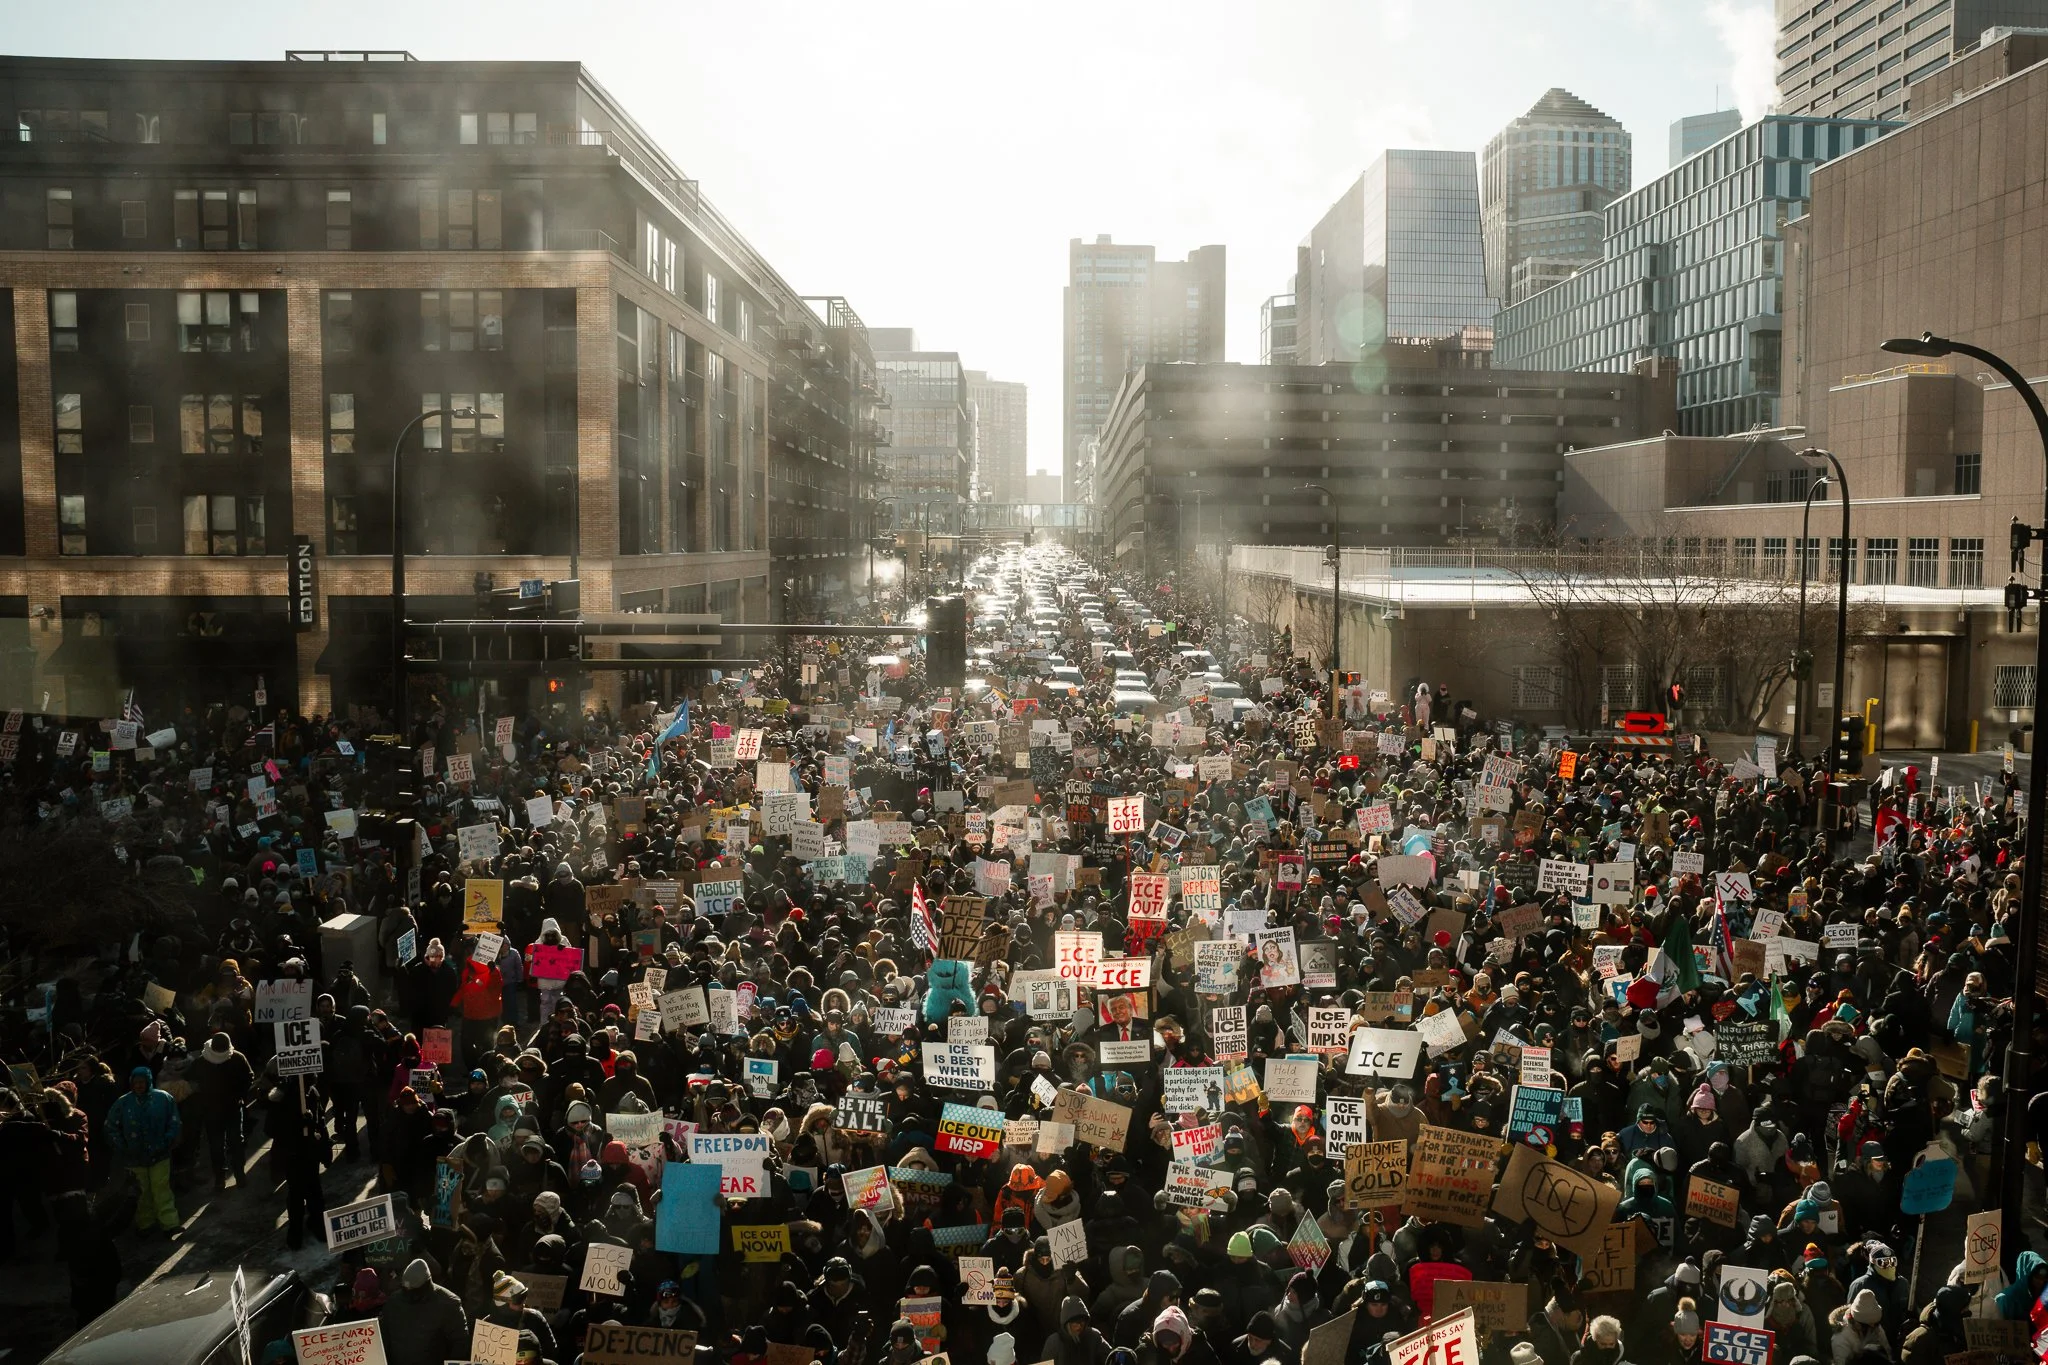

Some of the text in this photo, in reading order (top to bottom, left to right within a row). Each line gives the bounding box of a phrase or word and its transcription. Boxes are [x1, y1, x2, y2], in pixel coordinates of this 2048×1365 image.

[298, 544, 314, 623] EDITION
[498, 724, 511, 733] ICE
[973, 724, 987, 733] BE
[1297, 722, 1315, 731] ICE
[496, 733, 511, 743] OUT!
[739, 737, 757, 747] ICE
[968, 733, 994, 743] GOOD
[738, 746, 758, 756] OUT!
[451, 759, 470, 770] ICE
[452, 770, 473, 781] OUT!
[1065, 781, 1092, 793] RIGHTS
[1479, 785, 1501, 794] MICRO
[1068, 793, 1090, 805] LAWS
[1479, 794, 1504, 804] PENIS
[769, 803, 796, 814] ICE
[1112, 805, 1139, 817] ICE
[1113, 818, 1141, 831] OUT!
[815, 859, 843, 868] ICE OUT
[696, 881, 743, 898] ABOLISH
[1134, 883, 1163, 899] ICE
[1183, 881, 1219, 894] REPEATS
[704, 898, 732, 914] ICE
[945, 897, 981, 917] ICE
[1132, 900, 1164, 916] OUT!
[1185, 894, 1218, 909] ITSELF
[941, 916, 982, 935] DEEZ
[1759, 912, 1781, 926] ICE
[1259, 930, 1291, 941] Heartless
[938, 939, 978, 960] NUTZ
[1061, 948, 1095, 963] ICE
[1060, 965, 1097, 980] OUT!
[1102, 970, 1141, 987] ICE
[260, 982, 307, 995] MN NICE
[1032, 982, 1051, 992] SPOT
[1371, 993, 1410, 1003] ICE OUT
[258, 1006, 302, 1020] NO ICE
[876, 1010, 895, 1019] MN
[1034, 1012, 1069, 1020] DIFFERENCE
[1218, 1007, 1242, 1020] KILLER
[1315, 1012, 1345, 1020] ICE
[1215, 1020, 1245, 1033] ICE
[1719, 1025, 1768, 1033] INJUSTICE
[284, 1021, 312, 1047] ICE
[1312, 1032, 1346, 1046] MPLS
[277, 1048, 320, 1058] OUT OF
[949, 1045, 969, 1054] ICE
[1216, 1040, 1247, 1054] STREETS
[1719, 1042, 1775, 1053] IS A THREAT
[1736, 1049, 1770, 1057] JUSTICE
[278, 1055, 322, 1068] MINNESOTA
[934, 1055, 982, 1066] IS BEST
[1358, 1051, 1402, 1068] ICE
[939, 1066, 979, 1077] WHEN
[1208, 1068, 1220, 1076] just
[928, 1076, 991, 1090] CRUSHED!
[1165, 1086, 1185, 1094] trophy
[1518, 1089, 1562, 1102] NOBODY IS
[839, 1098, 884, 1114] BE THE
[1059, 1092, 1087, 1109] STOP
[1516, 1099, 1545, 1112] ILLEGAL
[1334, 1102, 1358, 1114] ICE
[836, 1111, 885, 1132] SALT
[1065, 1108, 1118, 1125] STEALING
[1330, 1115, 1362, 1127] OUT
[1514, 1110, 1557, 1124] ON STOLEN
[940, 1120, 1000, 1141] ICE OUT
[1072, 1119, 1106, 1138] PEOPLE
[1511, 1121, 1533, 1132] LAND
[1173, 1124, 1222, 1147] IMPEACH
[1330, 1129, 1362, 1143] OF MN
[694, 1137, 767, 1153] FREEDOM
[948, 1136, 984, 1153] MSP
[1172, 1165, 1216, 1179] THE ONLY
[1445, 1168, 1467, 1177] BUT
[1177, 1176, 1209, 1188] ORANGE
[1351, 1172, 1403, 1192] COLD
[1167, 1184, 1204, 1197] MONARCH
[1704, 1183, 1724, 1198] ICE
[907, 1193, 940, 1205] MSP
[1174, 1195, 1204, 1207] ADMIRE
[1690, 1191, 1735, 1212] MURDERS
[339, 1206, 380, 1230] ICE OUT!
[1688, 1202, 1734, 1223] AMERICANS
[740, 1231, 782, 1240] ICE OUT
[1054, 1227, 1078, 1247] MN
[741, 1240, 783, 1254] NOW!
[592, 1247, 626, 1265] ICE
[592, 1262, 622, 1276] OUT
[584, 1275, 622, 1291] NOW
[477, 1323, 510, 1344] ICE
[1712, 1330, 1768, 1350] ICE
[587, 1325, 693, 1357] DE-ICING
[1398, 1323, 1465, 1360] NEIGHBORS SAY
[341, 1347, 366, 1356] YOUR
[477, 1341, 508, 1359] OUT
[1710, 1343, 1762, 1365] OUT
